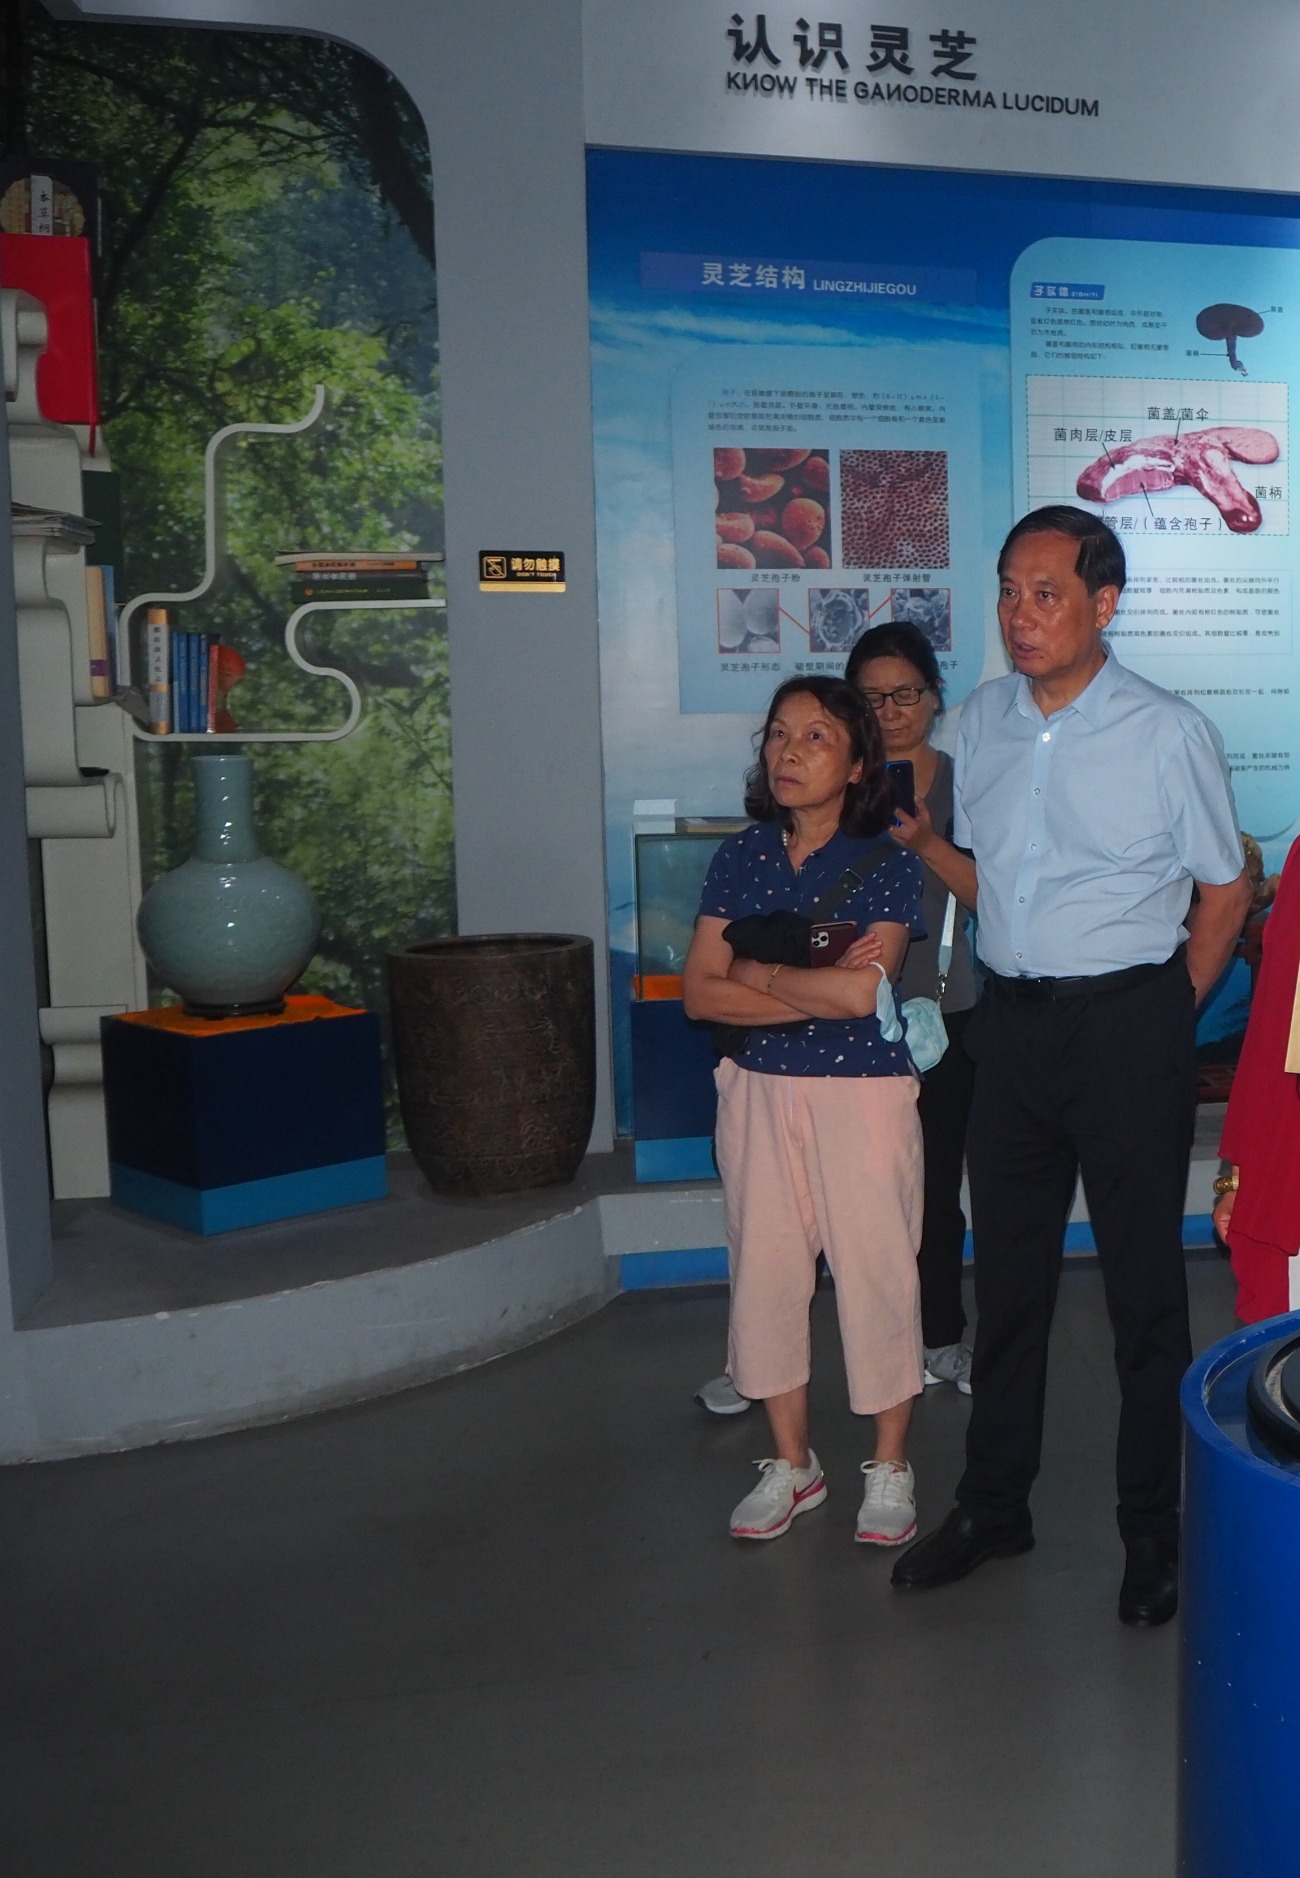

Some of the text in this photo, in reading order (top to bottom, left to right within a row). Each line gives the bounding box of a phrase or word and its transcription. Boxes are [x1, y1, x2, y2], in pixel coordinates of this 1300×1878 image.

[727, 14, 979, 80] 认识灵芝
[726, 71, 1100, 118] KNOW THE GANODERMA LUCIDUM
[701, 262, 917, 296] 灵芝结构 LINGZHIJIEGOU
[1147, 407, 1209, 421] 菌盖/菌伞
[1053, 427, 1133, 442] 菌肉层/皮层
[1255, 486, 1282, 500] 菌柄
[511, 557, 560, 571] 请勿触摸
